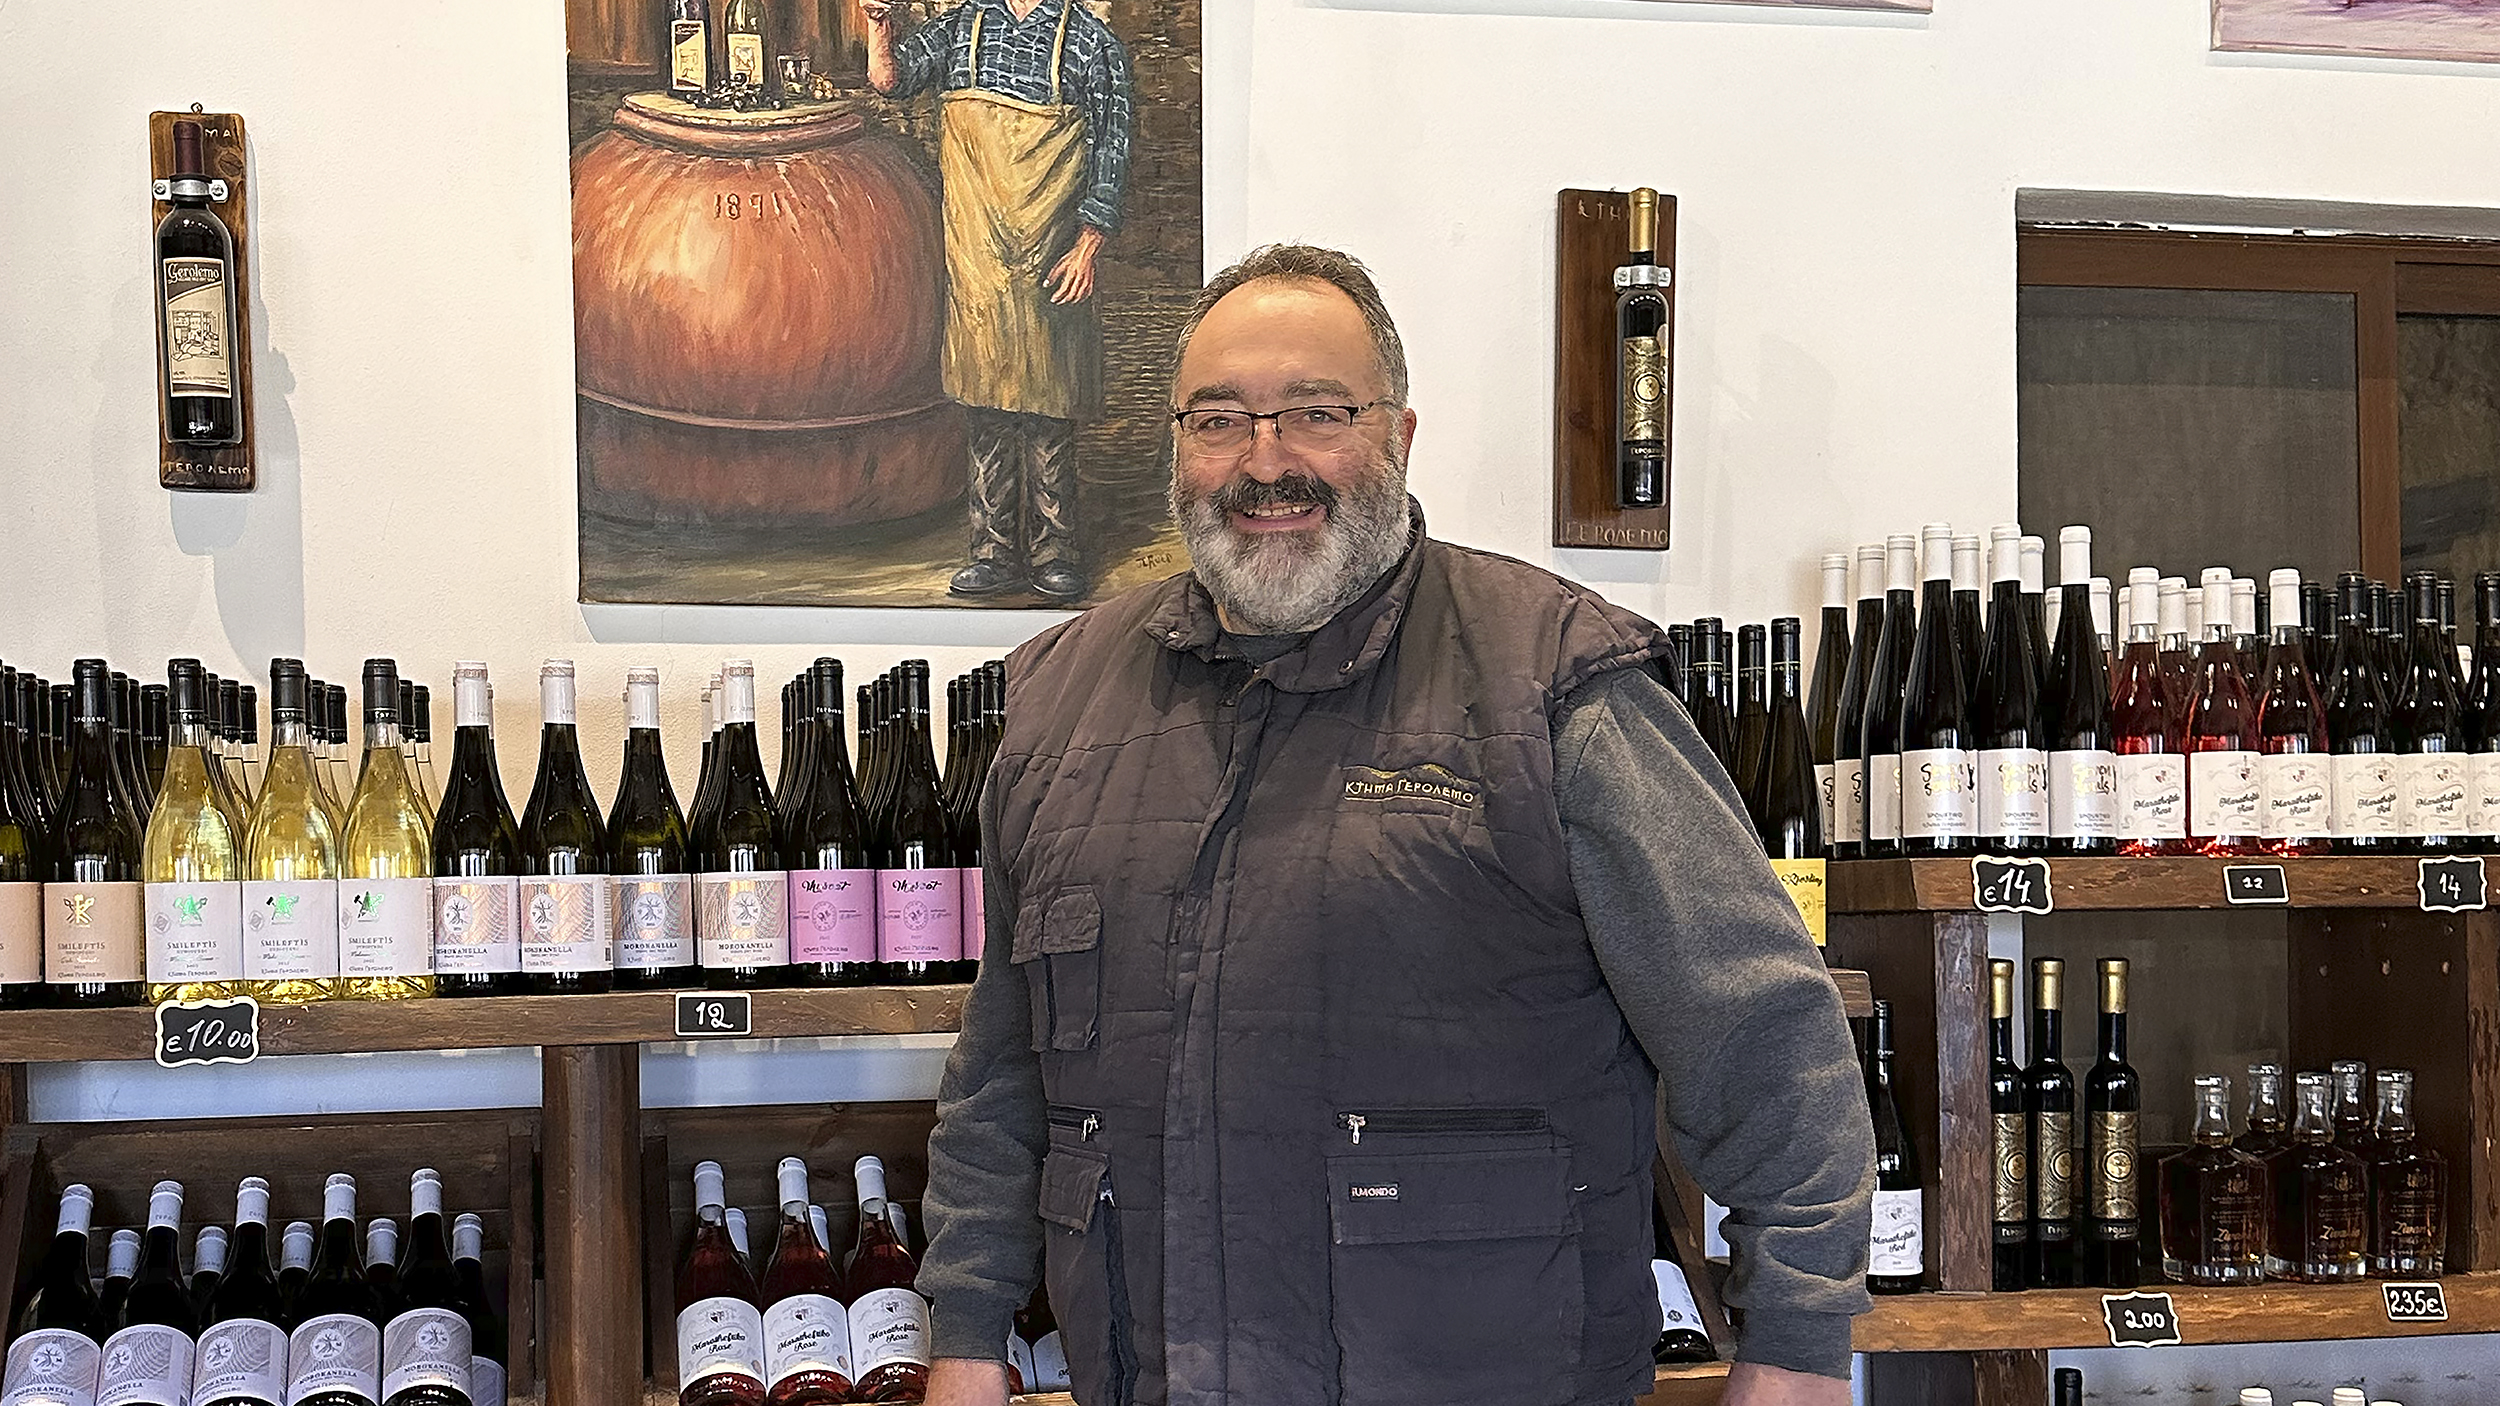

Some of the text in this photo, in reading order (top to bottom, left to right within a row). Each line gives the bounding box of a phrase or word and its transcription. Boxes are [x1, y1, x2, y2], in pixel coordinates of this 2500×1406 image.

[714, 192, 782, 220] 1891
[168, 263, 220, 284] Gerolemo
[2242, 876, 2263, 890] 12
[2439, 872, 2462, 900] 14
[695, 1001, 734, 1029] 12
[2124, 1309, 2165, 1329] 200
